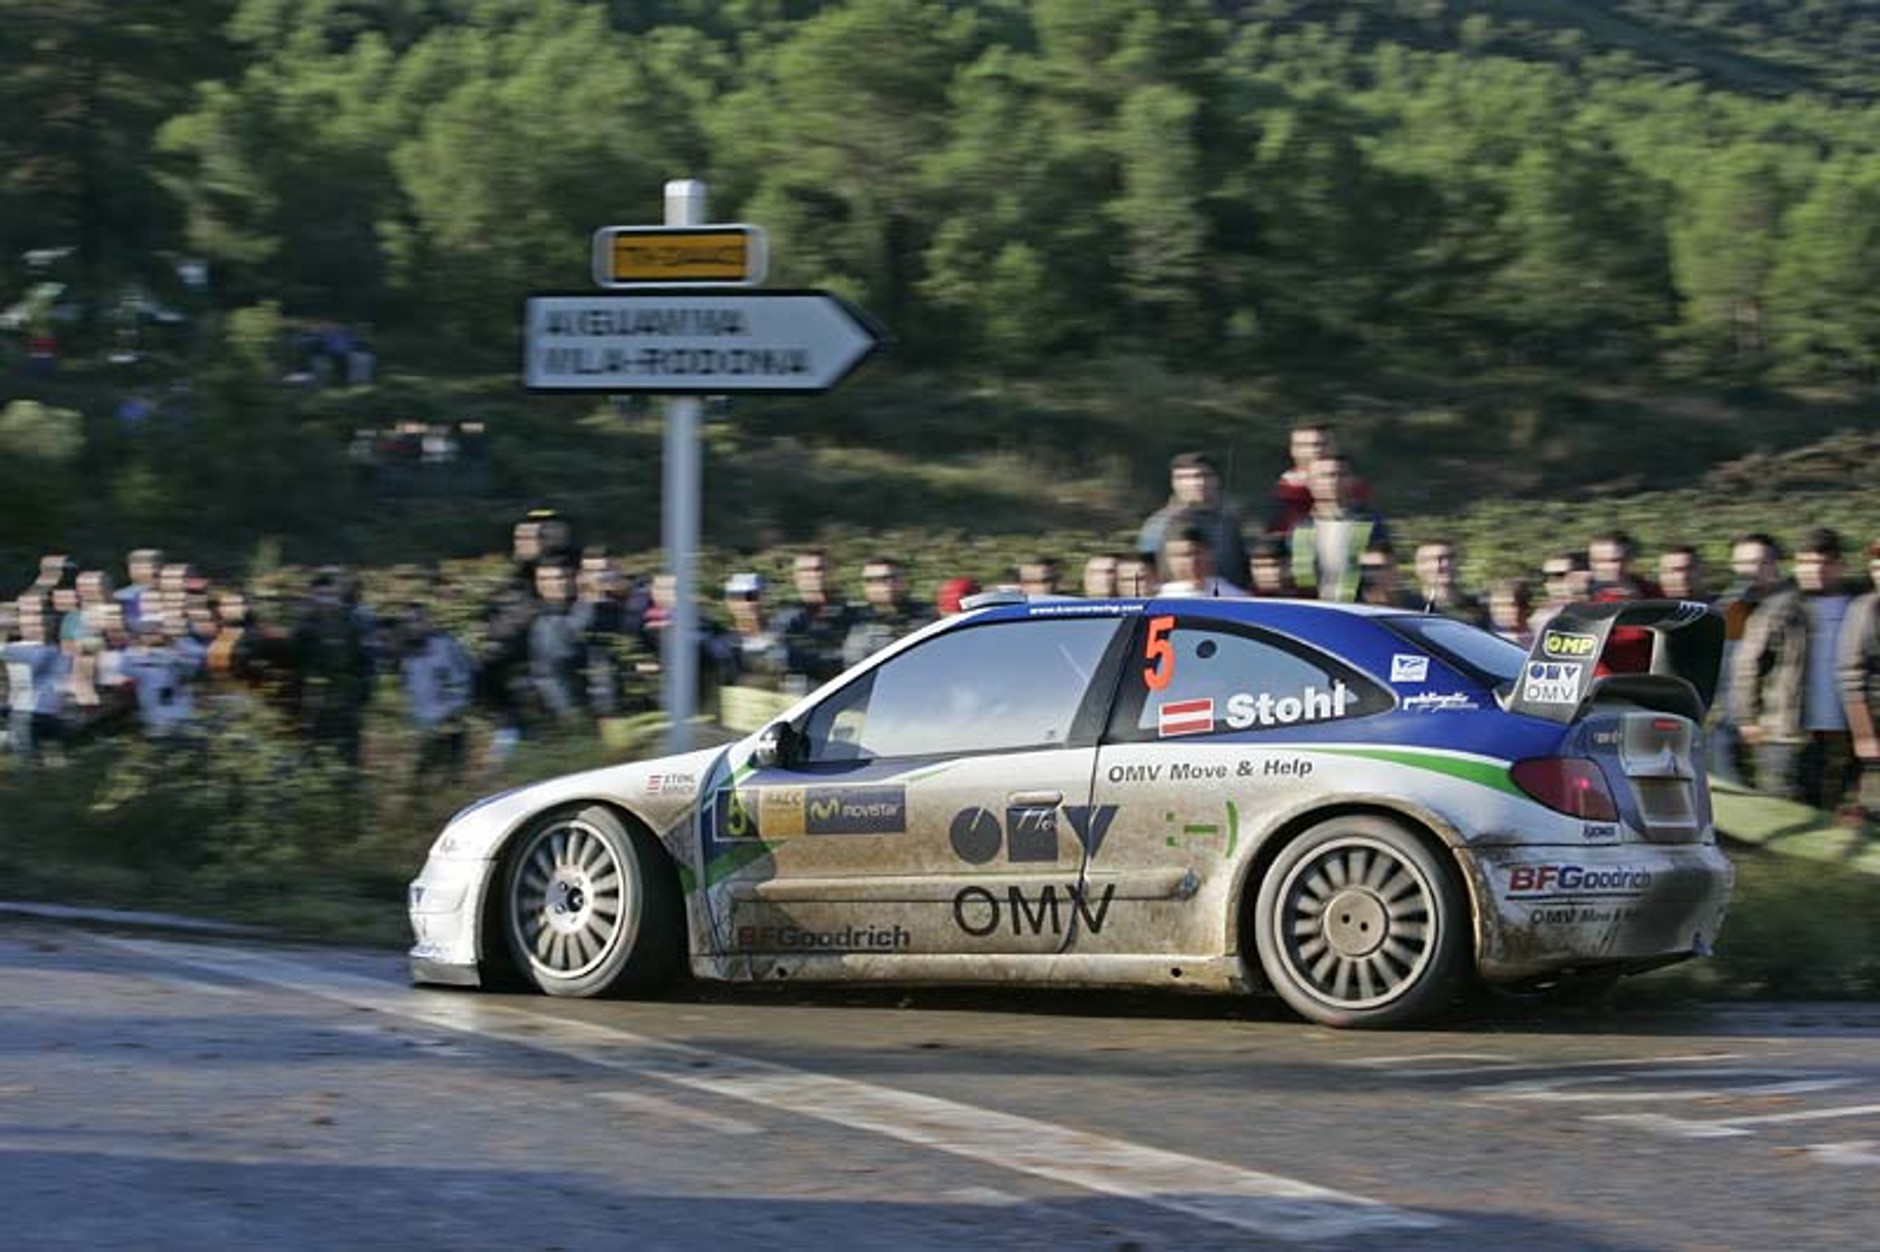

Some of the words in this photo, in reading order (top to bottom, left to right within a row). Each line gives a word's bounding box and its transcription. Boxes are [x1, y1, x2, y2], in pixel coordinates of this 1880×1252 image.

[546, 347, 811, 375] VILA-RODONA
[1143, 615, 1176, 691] 5
[1547, 634, 1594, 656] OMP
[1525, 683, 1576, 702] OMV
[1225, 682, 1346, 729] Stohl
[1108, 764, 1162, 783] OMV
[1170, 761, 1228, 780] Move
[1236, 760, 1254, 777] &
[1264, 758, 1313, 778] Help
[726, 789, 747, 835] 5
[841, 803, 899, 818] movistar
[1509, 865, 1651, 891] BFGoodrich
[953, 883, 1117, 936] OMV
[1530, 908, 1576, 924] OMV
[737, 925, 911, 947] BFGoodrich
